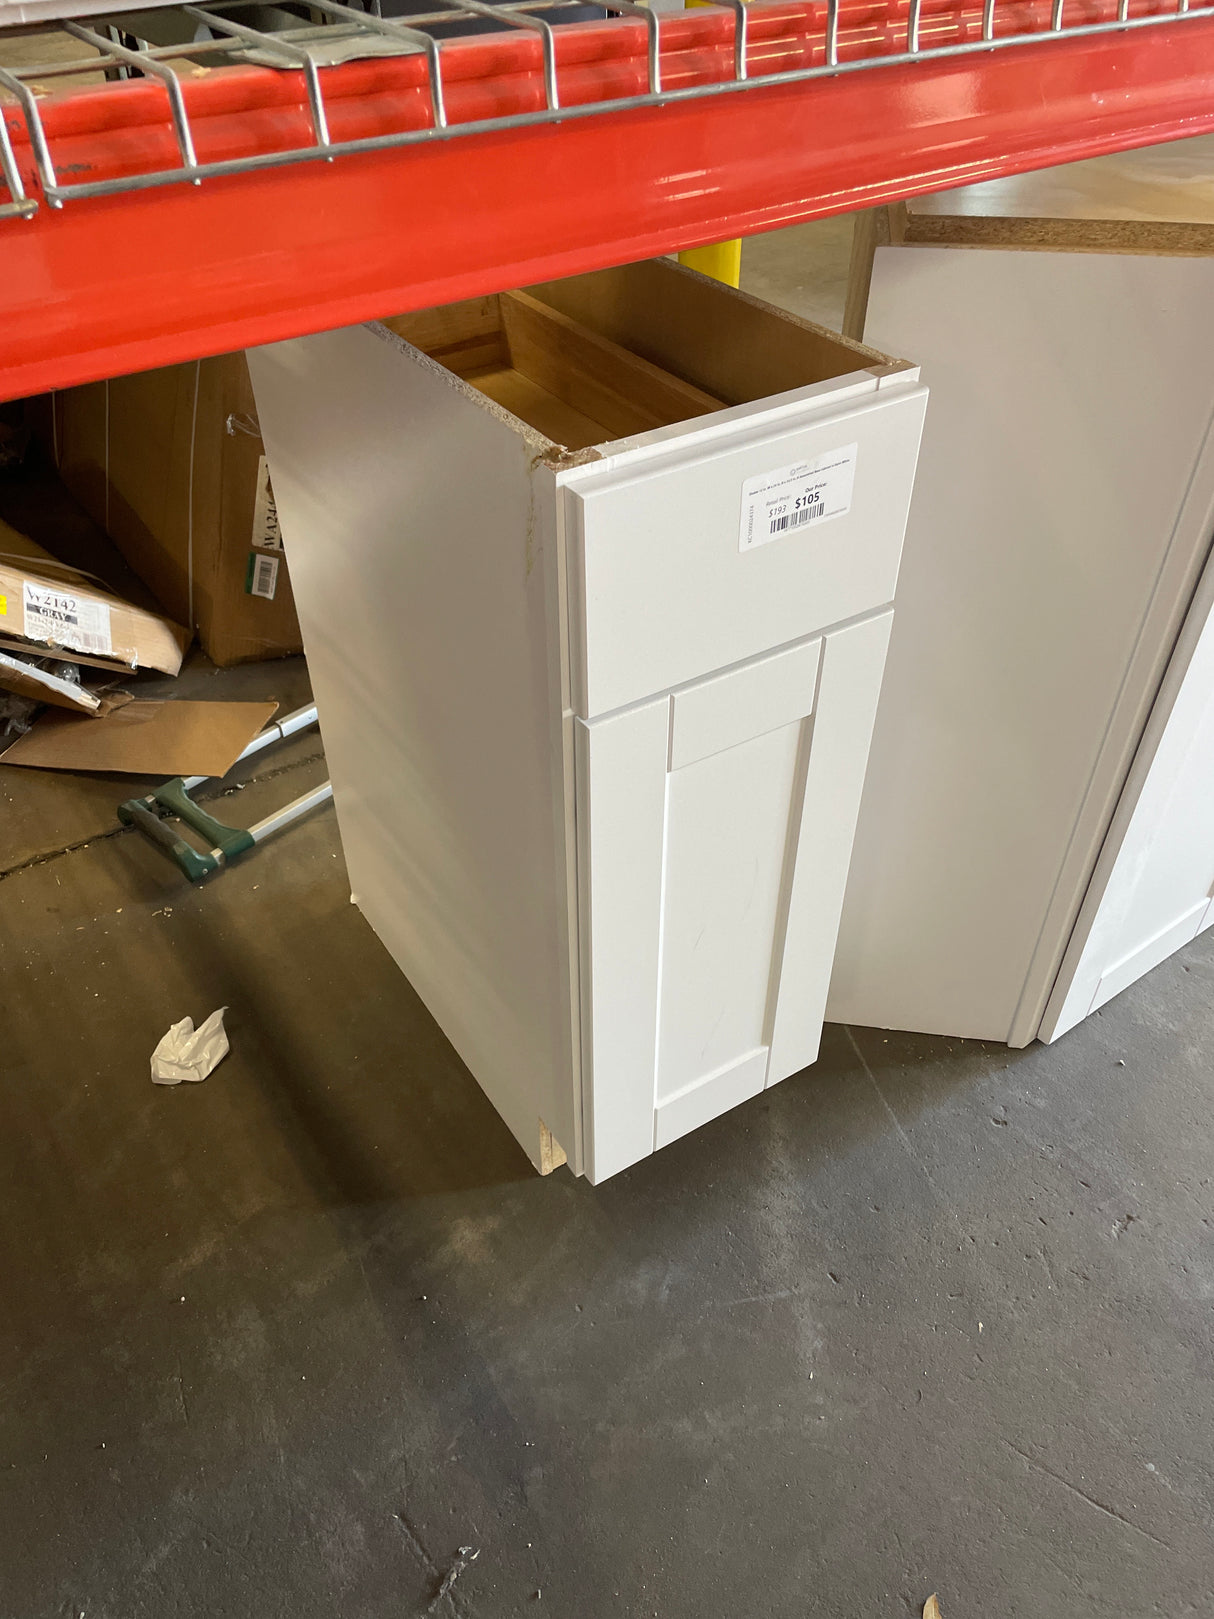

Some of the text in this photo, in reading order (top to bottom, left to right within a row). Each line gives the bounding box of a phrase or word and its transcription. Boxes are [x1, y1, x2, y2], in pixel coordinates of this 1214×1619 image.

[804, 486, 814, 494] Our
[795, 491, 820, 509] $105
[768, 504, 787, 518] $193
[39, 606, 66, 621] GRAY
